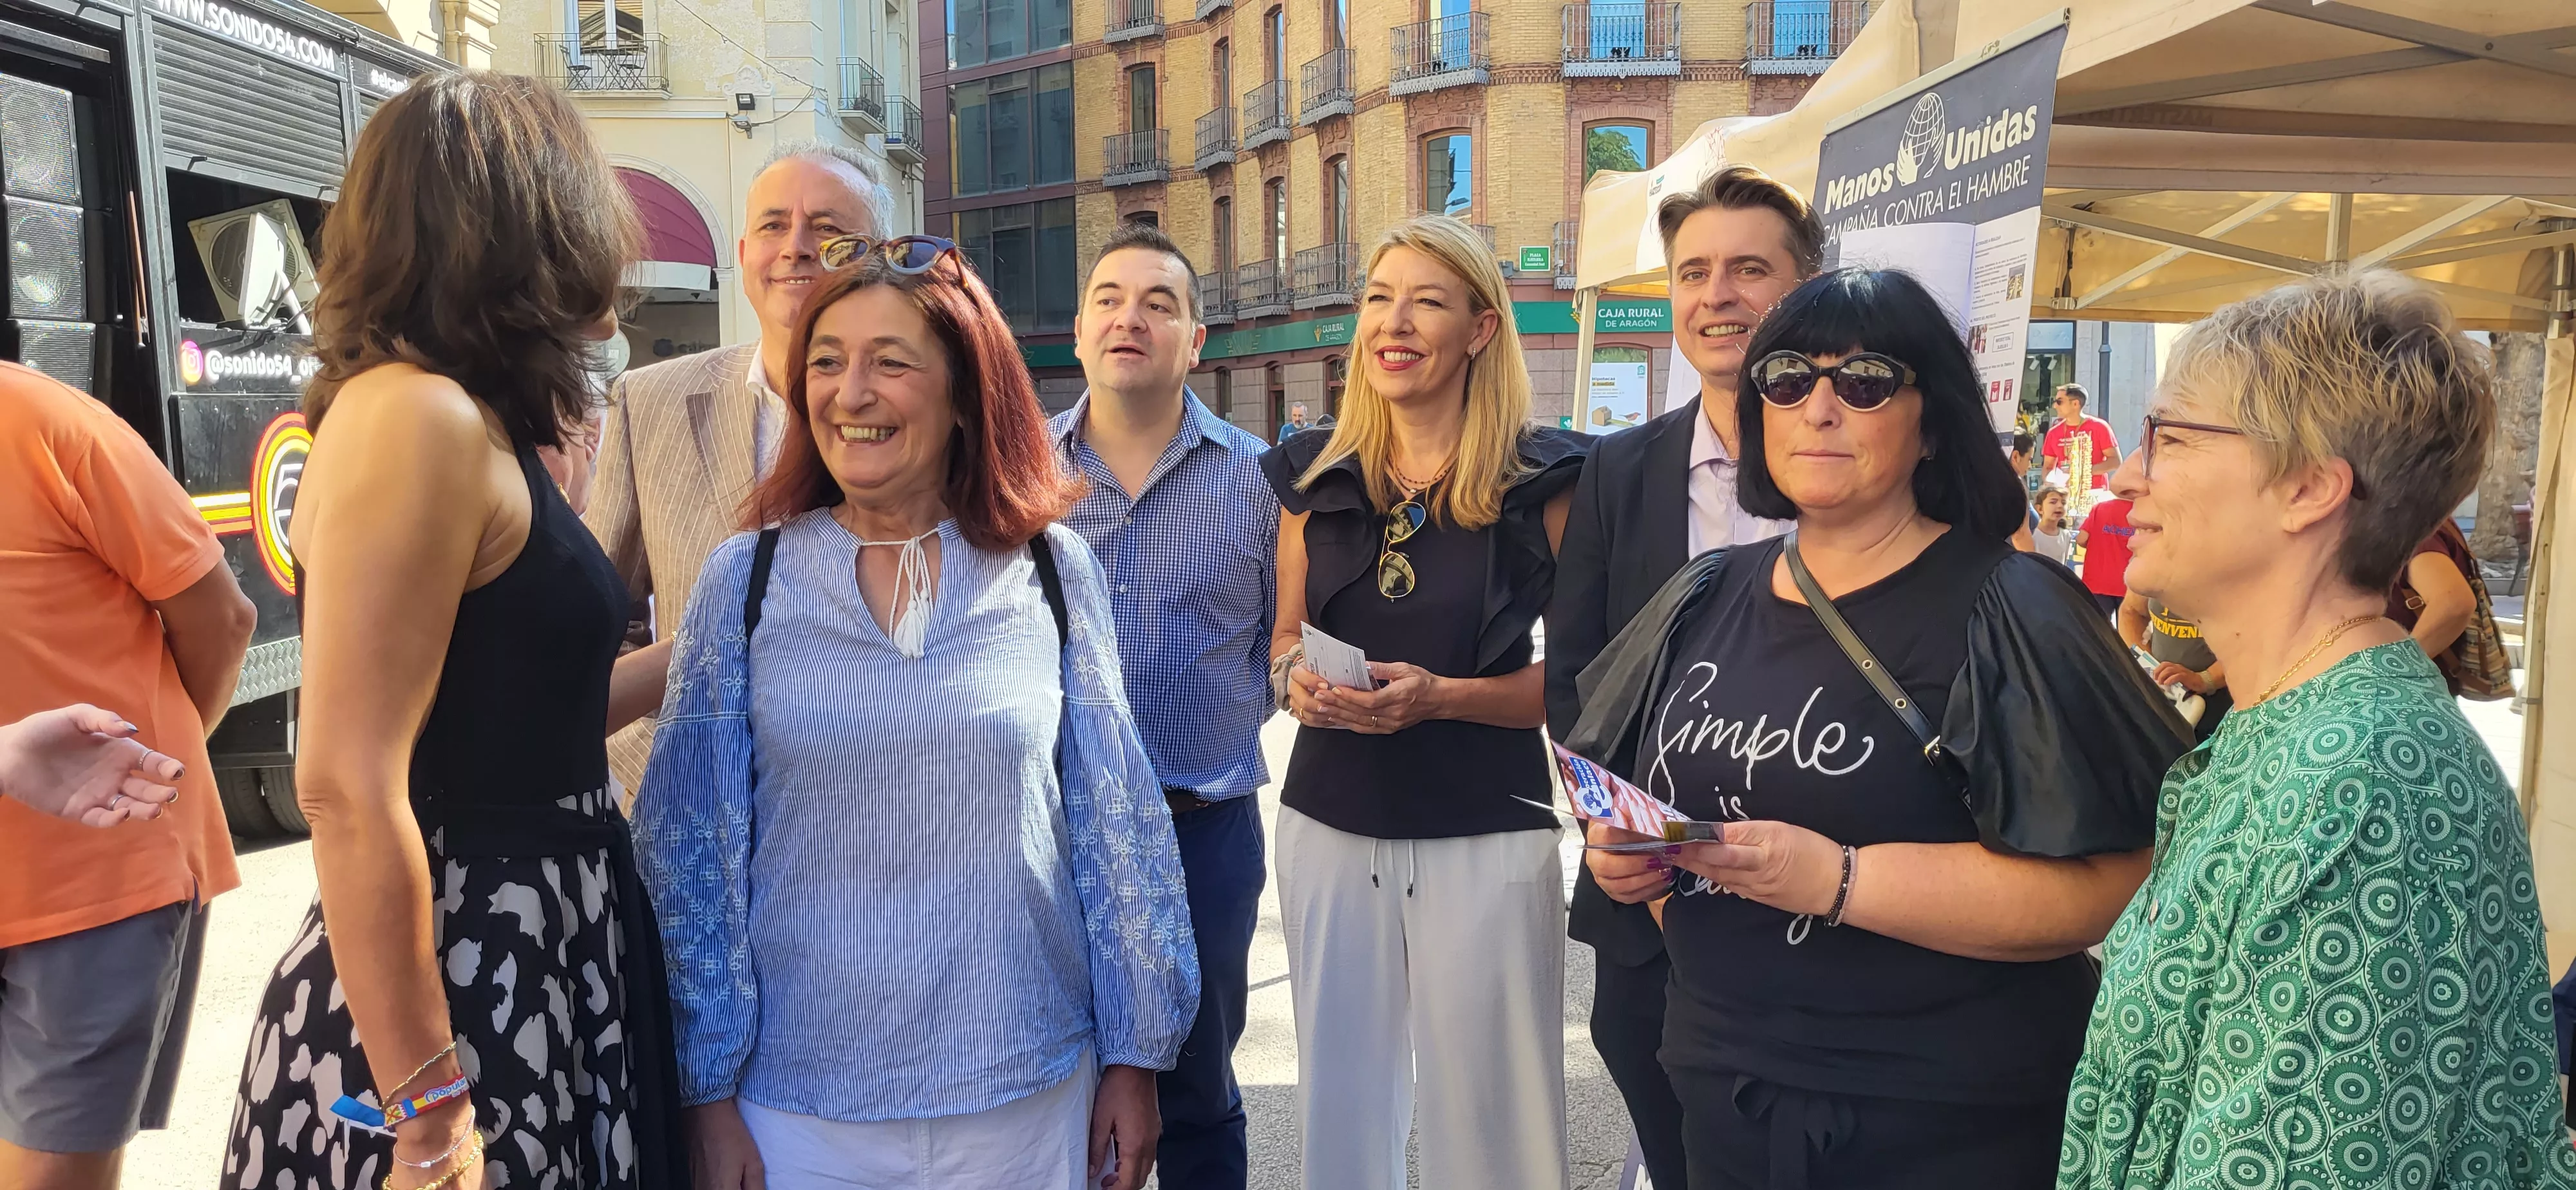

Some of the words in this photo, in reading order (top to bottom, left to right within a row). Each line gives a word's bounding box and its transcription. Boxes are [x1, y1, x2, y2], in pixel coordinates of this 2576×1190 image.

[1824, 162, 1895, 215] Manos
[1944, 105, 2038, 171] Unidas
[1884, 185, 1944, 227] CONTRA
[1947, 180, 1962, 211] EL
[1966, 154, 2032, 205] HAMBRE
[1598, 308, 1625, 317] CAJA
[1627, 308, 1664, 317] RURAL
[1619, 318, 1657, 327] ARAGÓN
[1648, 661, 1875, 807] Simple
[1714, 786, 1751, 820] is
